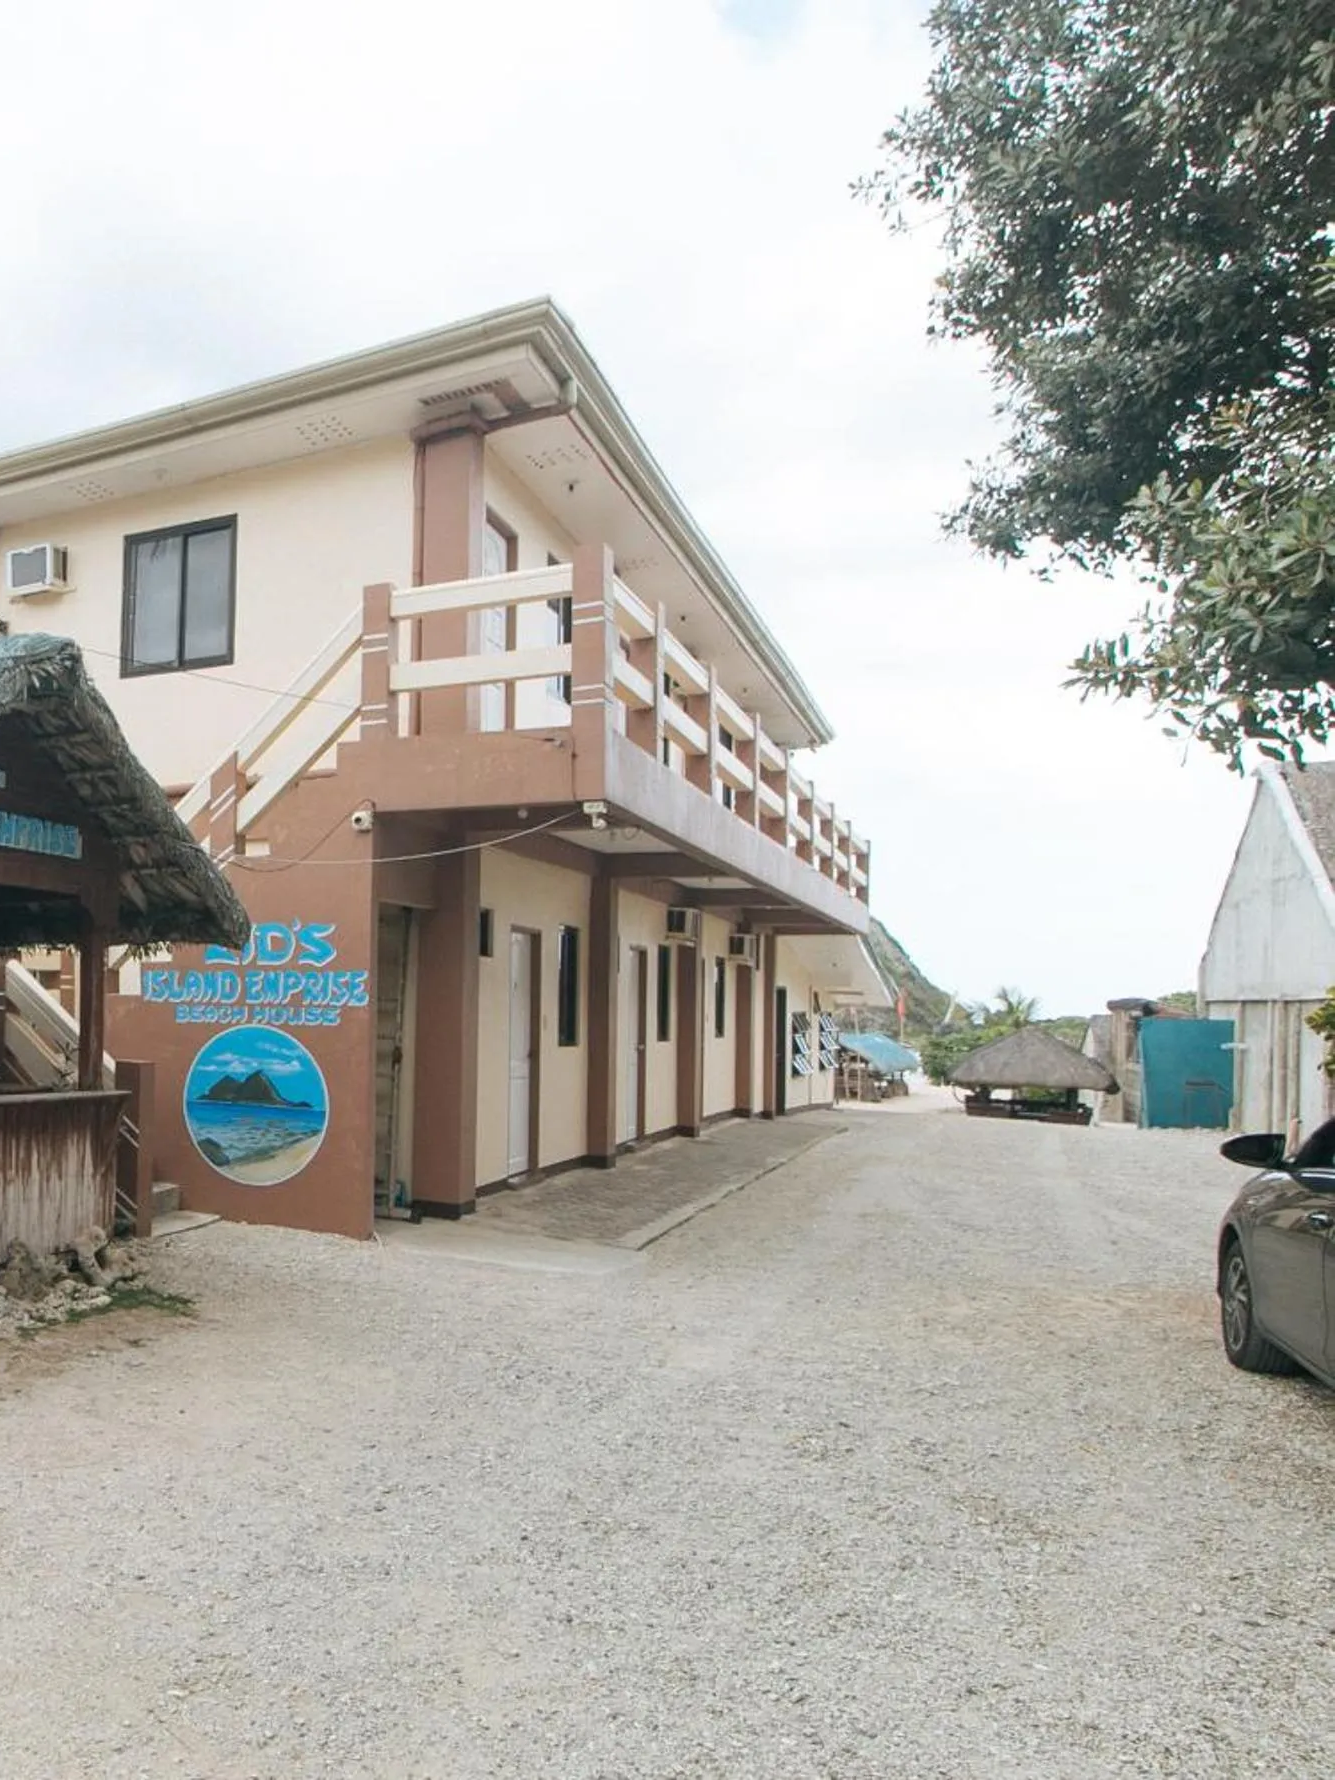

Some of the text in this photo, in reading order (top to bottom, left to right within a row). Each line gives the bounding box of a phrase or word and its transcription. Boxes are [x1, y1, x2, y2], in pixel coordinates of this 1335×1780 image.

[143, 969, 370, 1006] ISLAND EMPRISE
[175, 1004, 342, 1026] BEACH HOUSE
